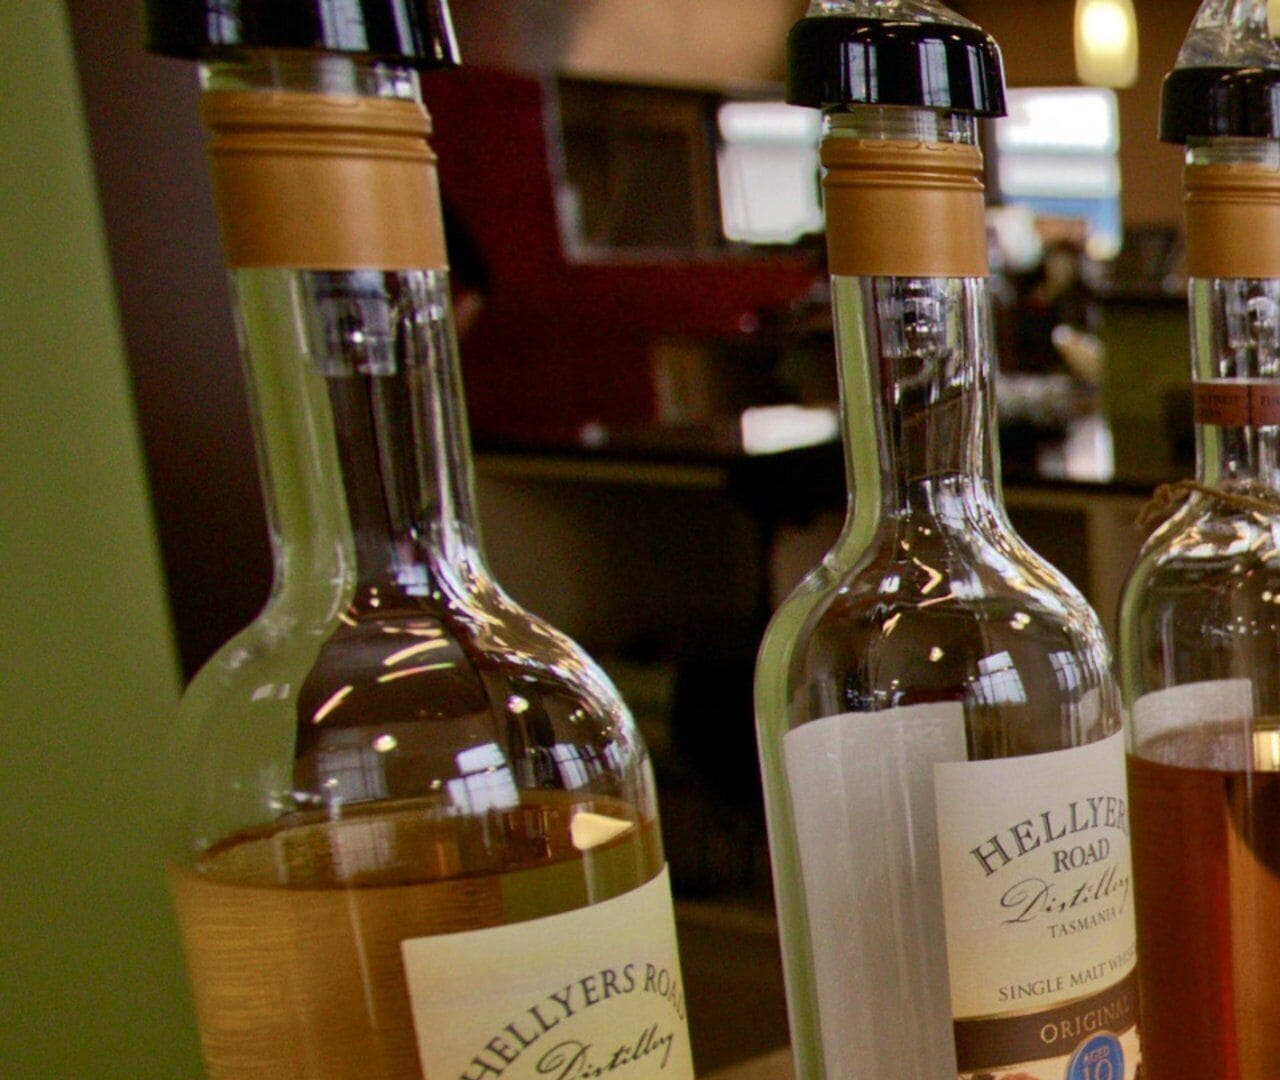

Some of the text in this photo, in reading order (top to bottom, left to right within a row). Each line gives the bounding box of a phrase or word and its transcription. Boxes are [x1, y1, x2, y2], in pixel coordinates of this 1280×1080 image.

[1053, 838, 1110, 873] ROAD
[1000, 864, 1129, 924] Distillery
[1047, 908, 1117, 938] TASMANIA
[999, 977, 1063, 1001] SINGLE
[1070, 962, 1106, 987] MALT
